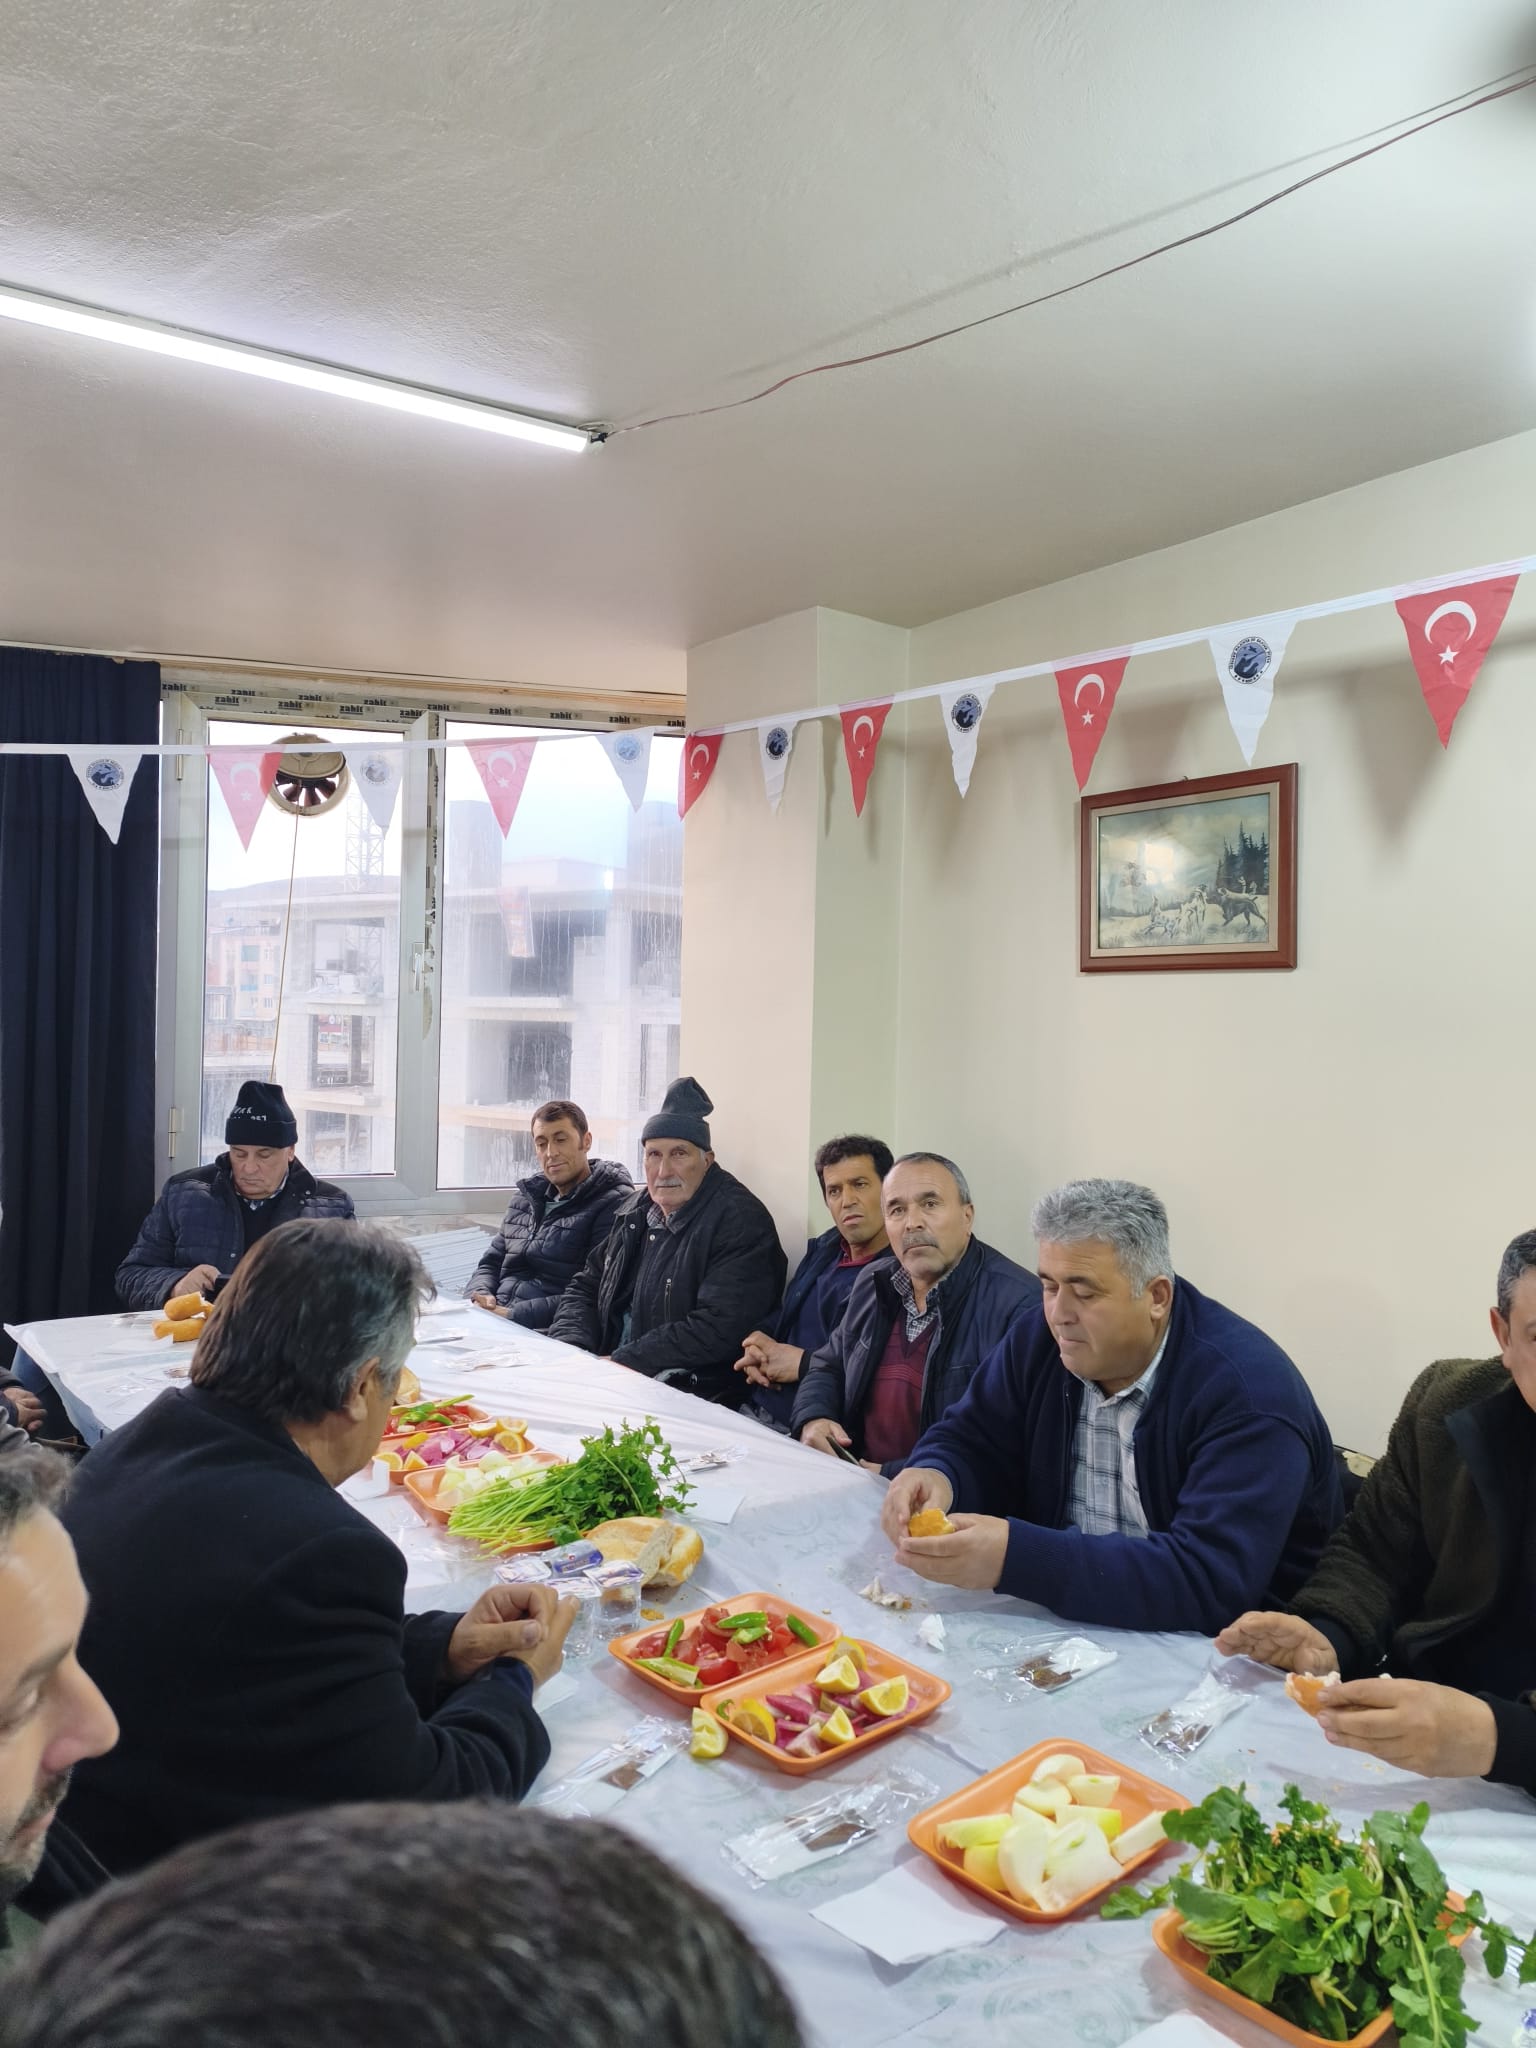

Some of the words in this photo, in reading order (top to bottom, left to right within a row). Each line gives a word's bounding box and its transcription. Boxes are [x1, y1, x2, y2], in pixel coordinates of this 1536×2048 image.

[215, 696, 240, 704] zahit
[278, 700, 303, 708] zahit
[340, 705, 363, 713] zahit
[609, 716, 630, 724] zahit
